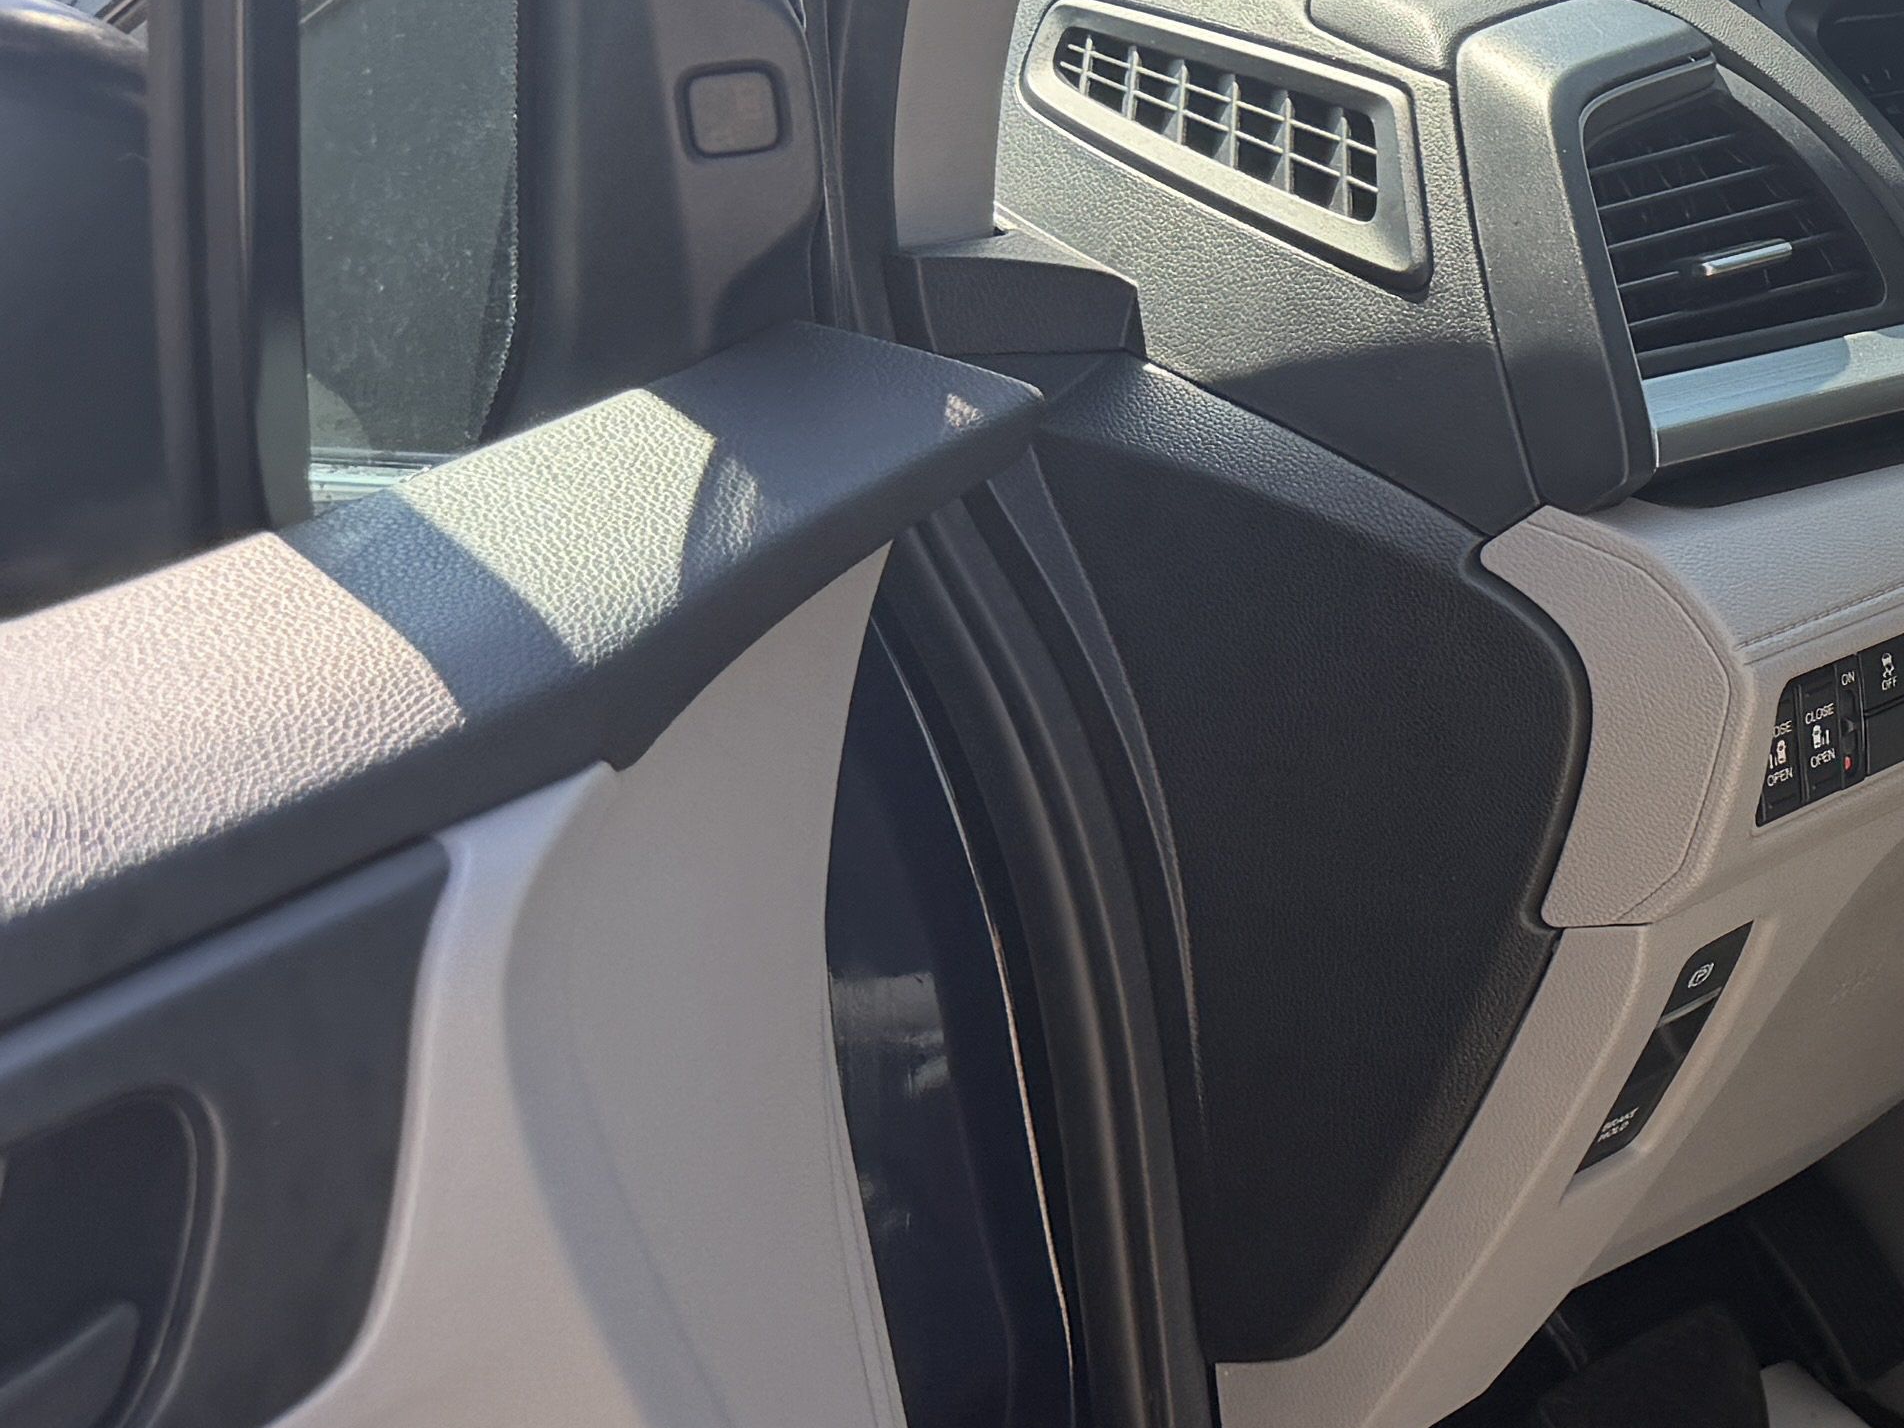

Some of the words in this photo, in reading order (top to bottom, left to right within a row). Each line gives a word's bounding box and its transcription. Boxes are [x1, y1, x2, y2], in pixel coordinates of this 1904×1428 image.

[1840, 671, 1856, 686] ON
[1881, 677, 1898, 691] OFF
[1804, 703, 1835, 725] CLOSE
[1772, 721, 1793, 737] OSE
[1810, 748, 1837, 769] OPEN
[1766, 767, 1794, 787] OPEN
